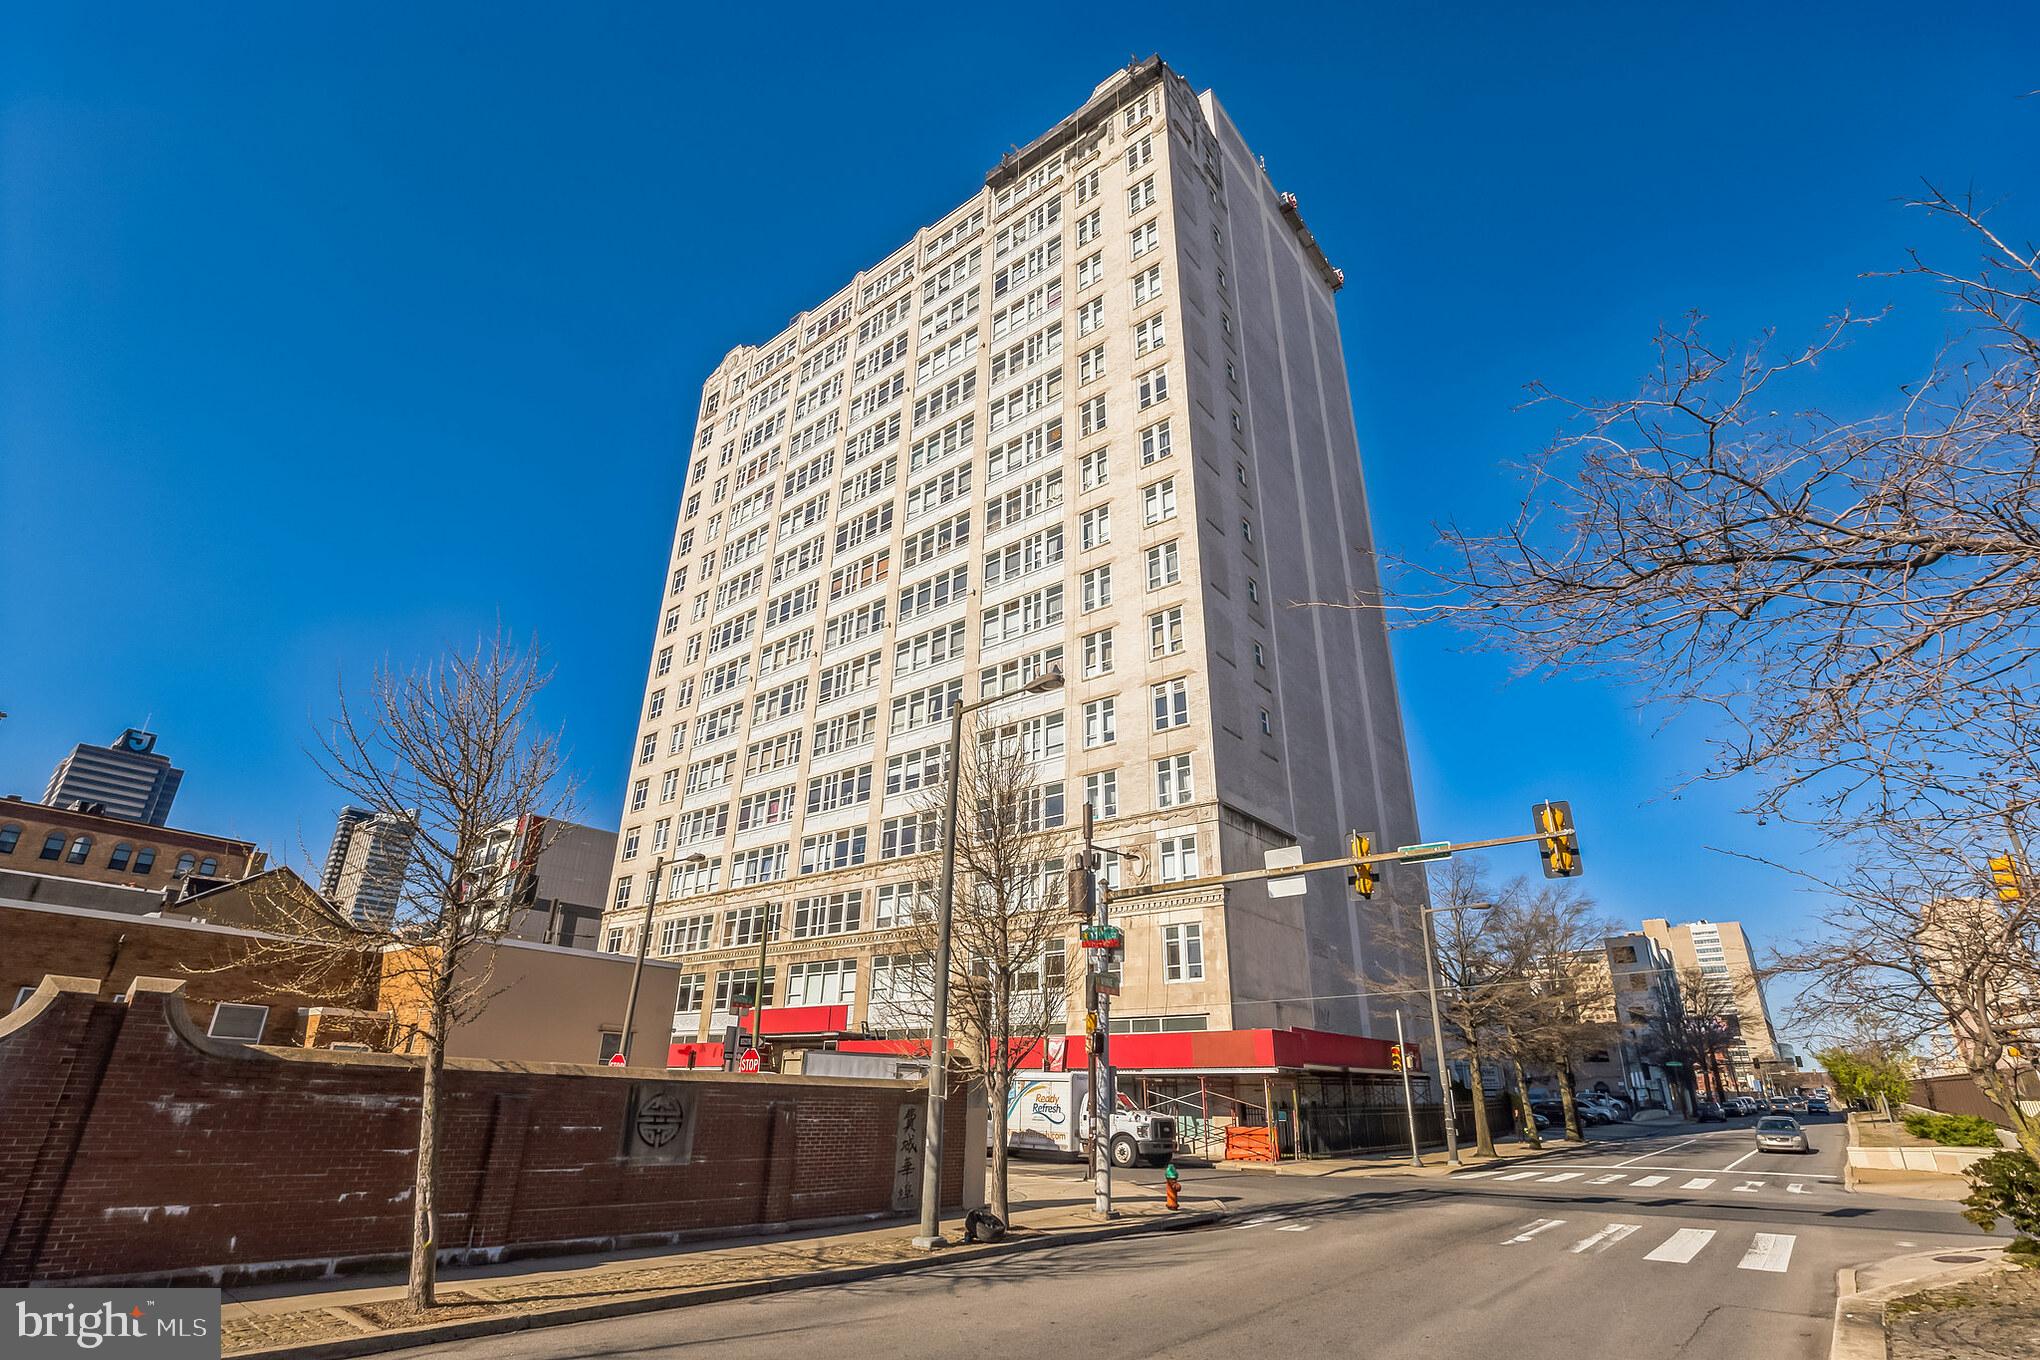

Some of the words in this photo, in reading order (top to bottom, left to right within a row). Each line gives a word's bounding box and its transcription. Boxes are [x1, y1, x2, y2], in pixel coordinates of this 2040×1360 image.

[741, 1059, 759, 1071] STOP
[1035, 1094, 1060, 1105] Ready
[1032, 1103, 1061, 1113] Refresh
